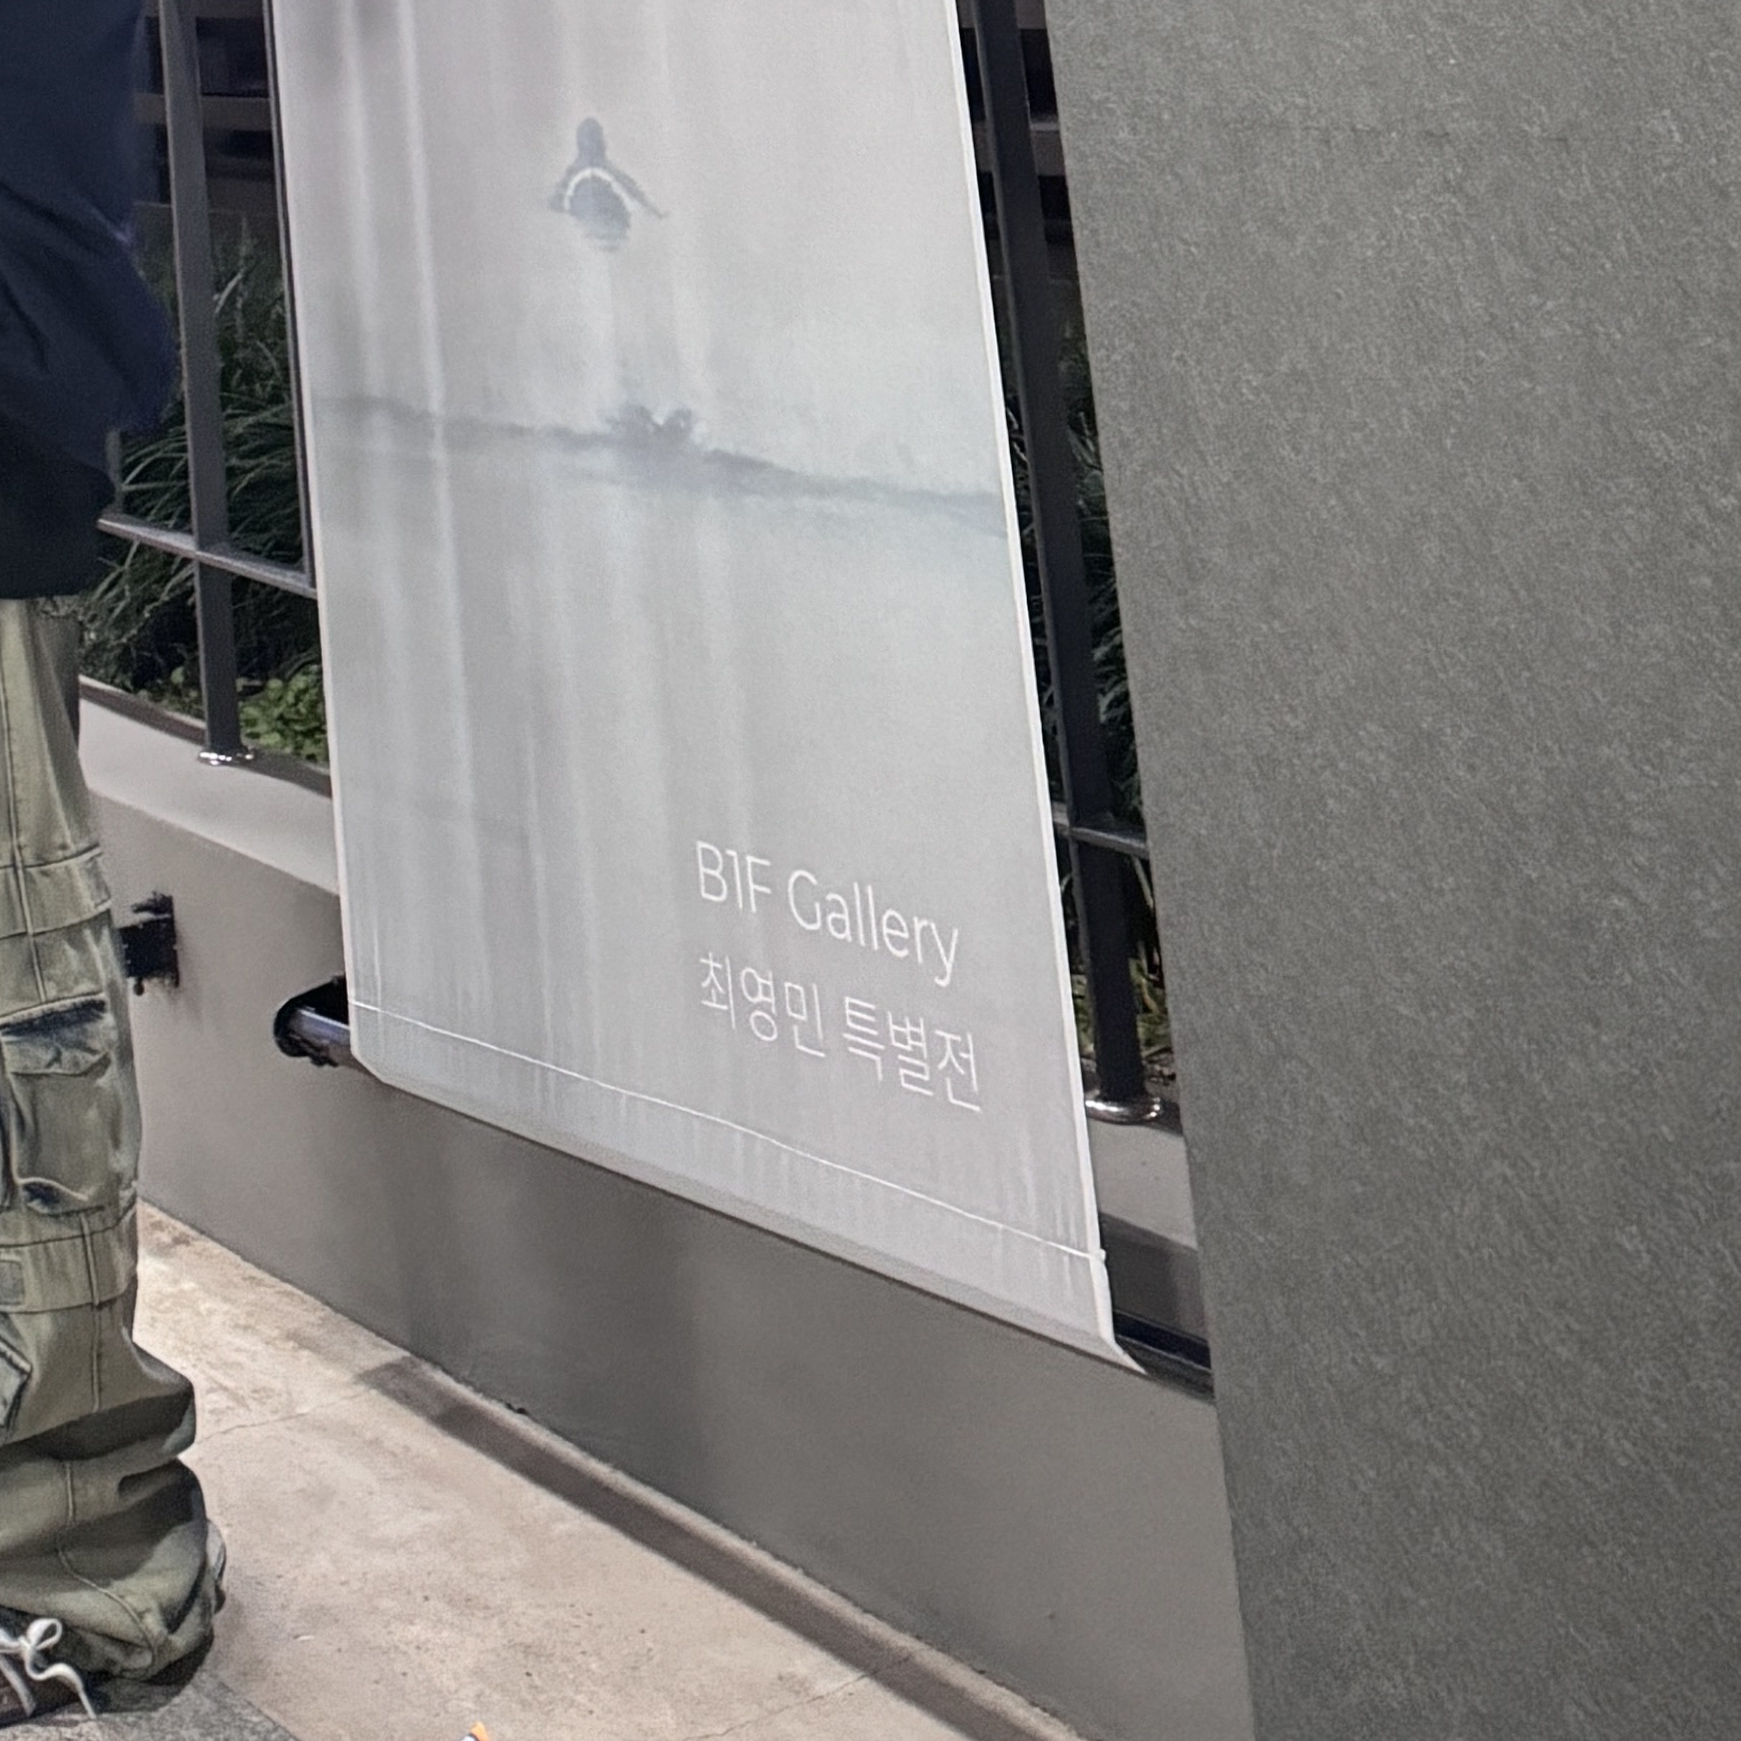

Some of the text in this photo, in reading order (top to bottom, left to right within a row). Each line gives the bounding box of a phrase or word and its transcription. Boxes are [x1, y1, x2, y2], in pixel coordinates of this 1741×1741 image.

[696, 840, 959, 987] B1F Gallery
[699, 951, 981, 1112] 최영민 특별전
